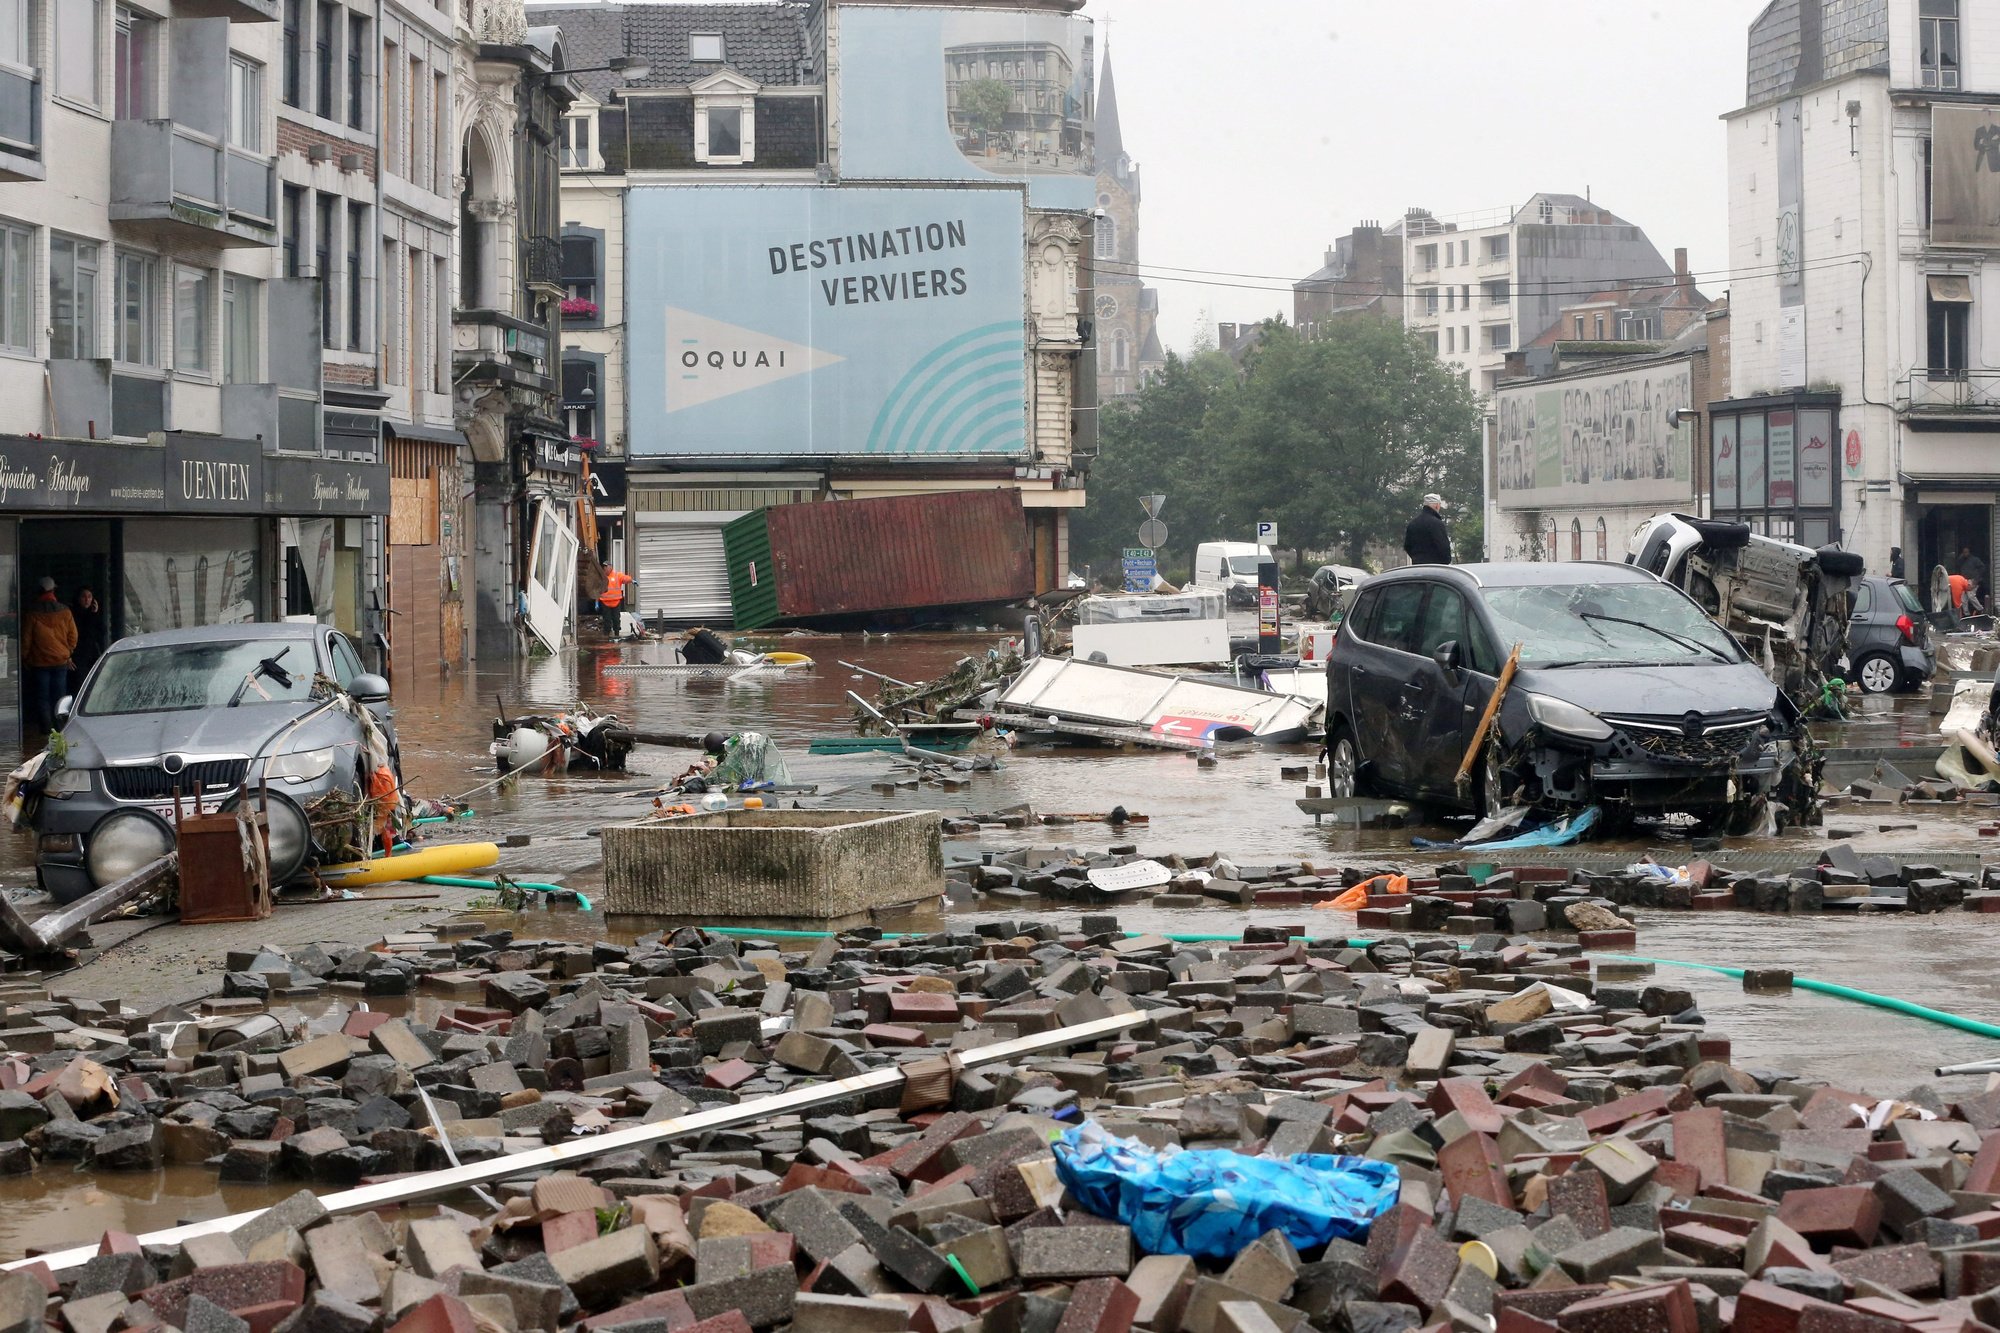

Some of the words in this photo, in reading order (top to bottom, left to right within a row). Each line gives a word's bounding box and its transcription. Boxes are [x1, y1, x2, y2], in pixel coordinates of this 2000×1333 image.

[768, 219, 967, 275] DESTINATION
[821, 267, 967, 306] VERVIERS
[47, 455, 90, 505] Horloger
[110, 487, 164, 499] www.bijouterie-uenten.be
[182, 460, 250, 501] UENTEN
[312, 473, 338, 511] Bijoutier
[346, 473, 370, 511] Horloger
[1259, 524, 1271, 536] P
[1178, 709, 1224, 719] market
